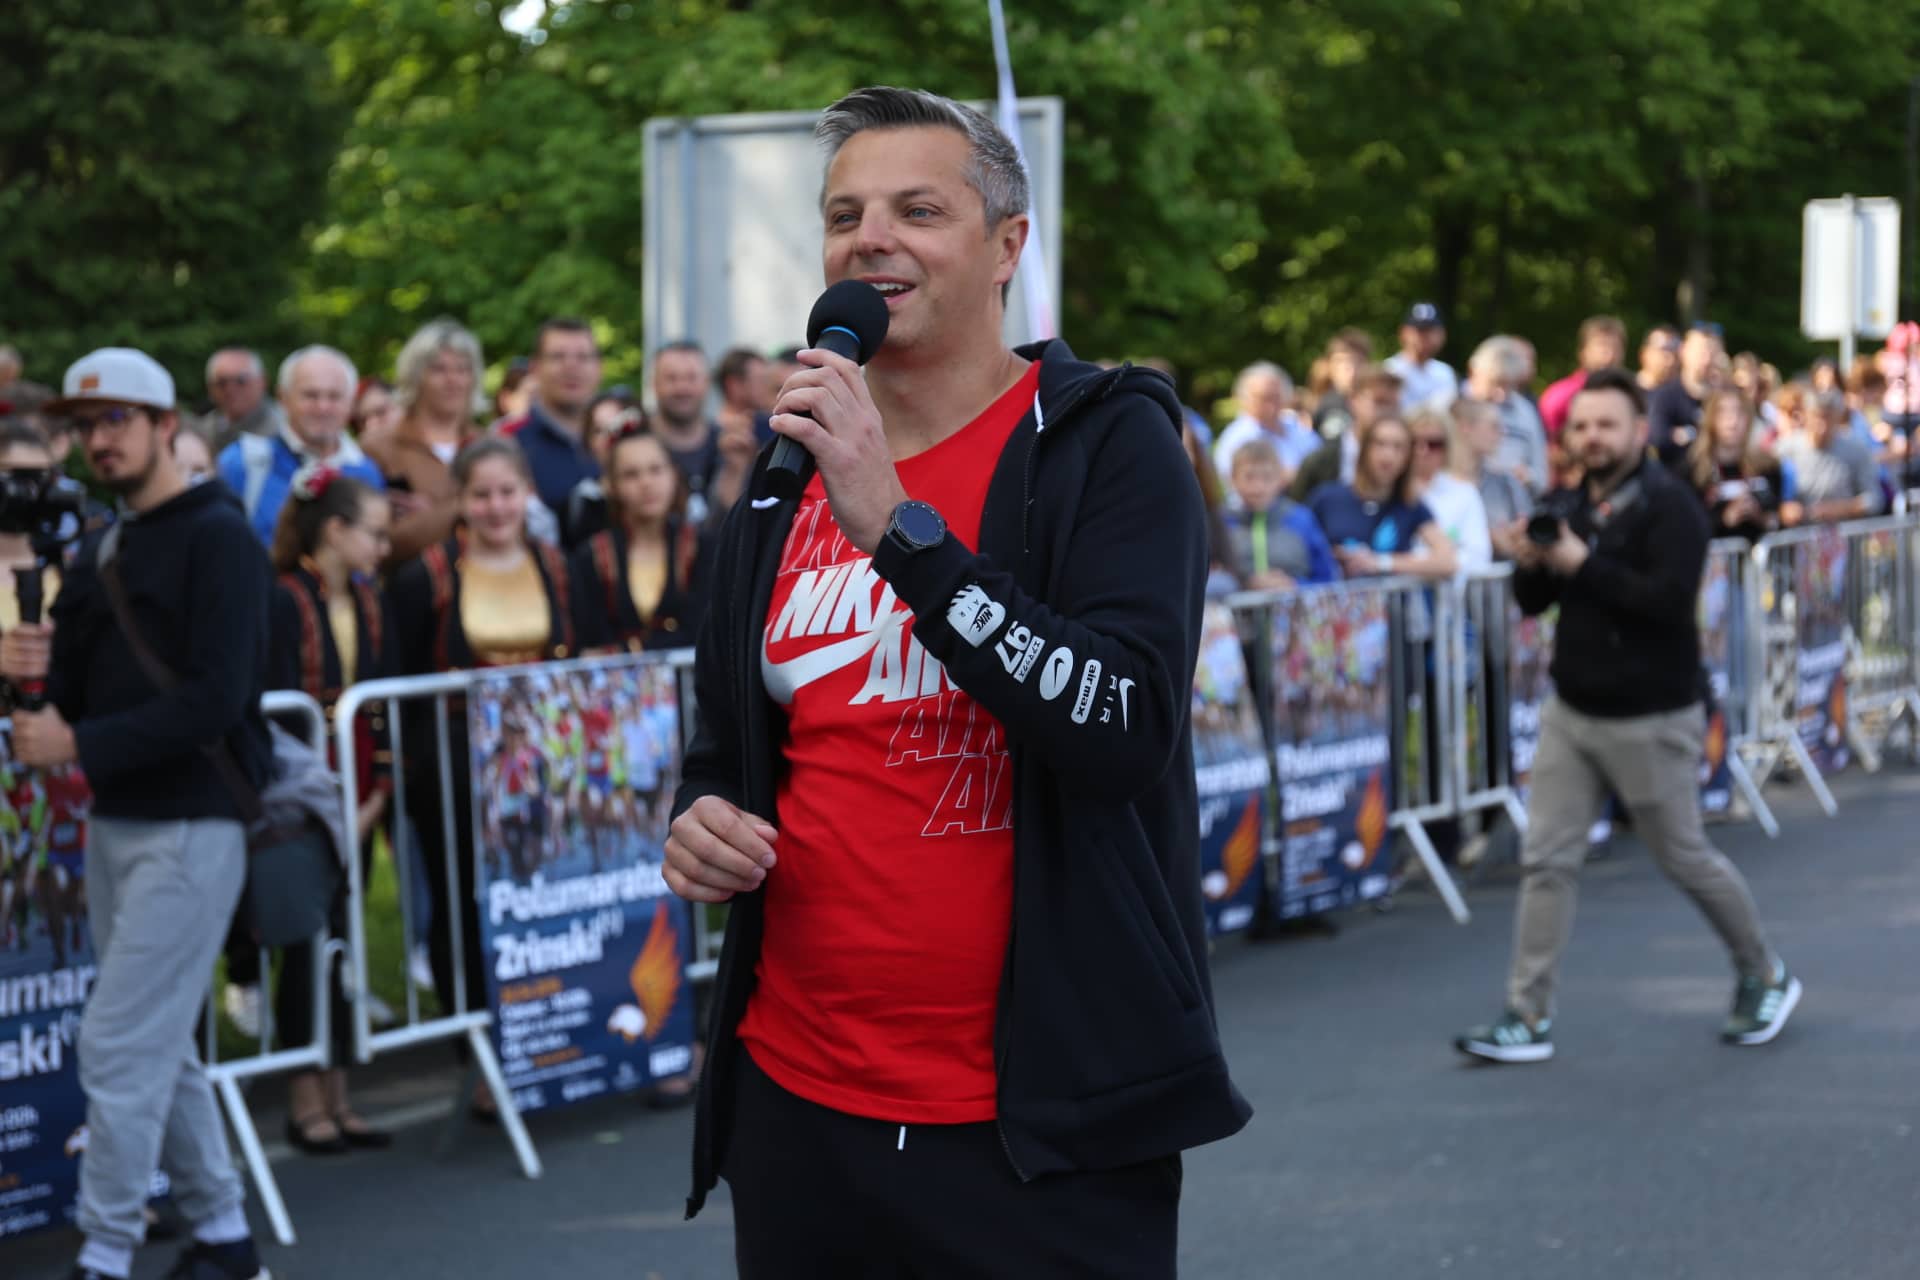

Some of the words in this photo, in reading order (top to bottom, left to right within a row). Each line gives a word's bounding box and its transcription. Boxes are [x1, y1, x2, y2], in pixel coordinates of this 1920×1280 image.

[974, 608, 993, 632] NIKE
[994, 620, 1031, 675] 97
[1099, 675, 1118, 723] AIR
